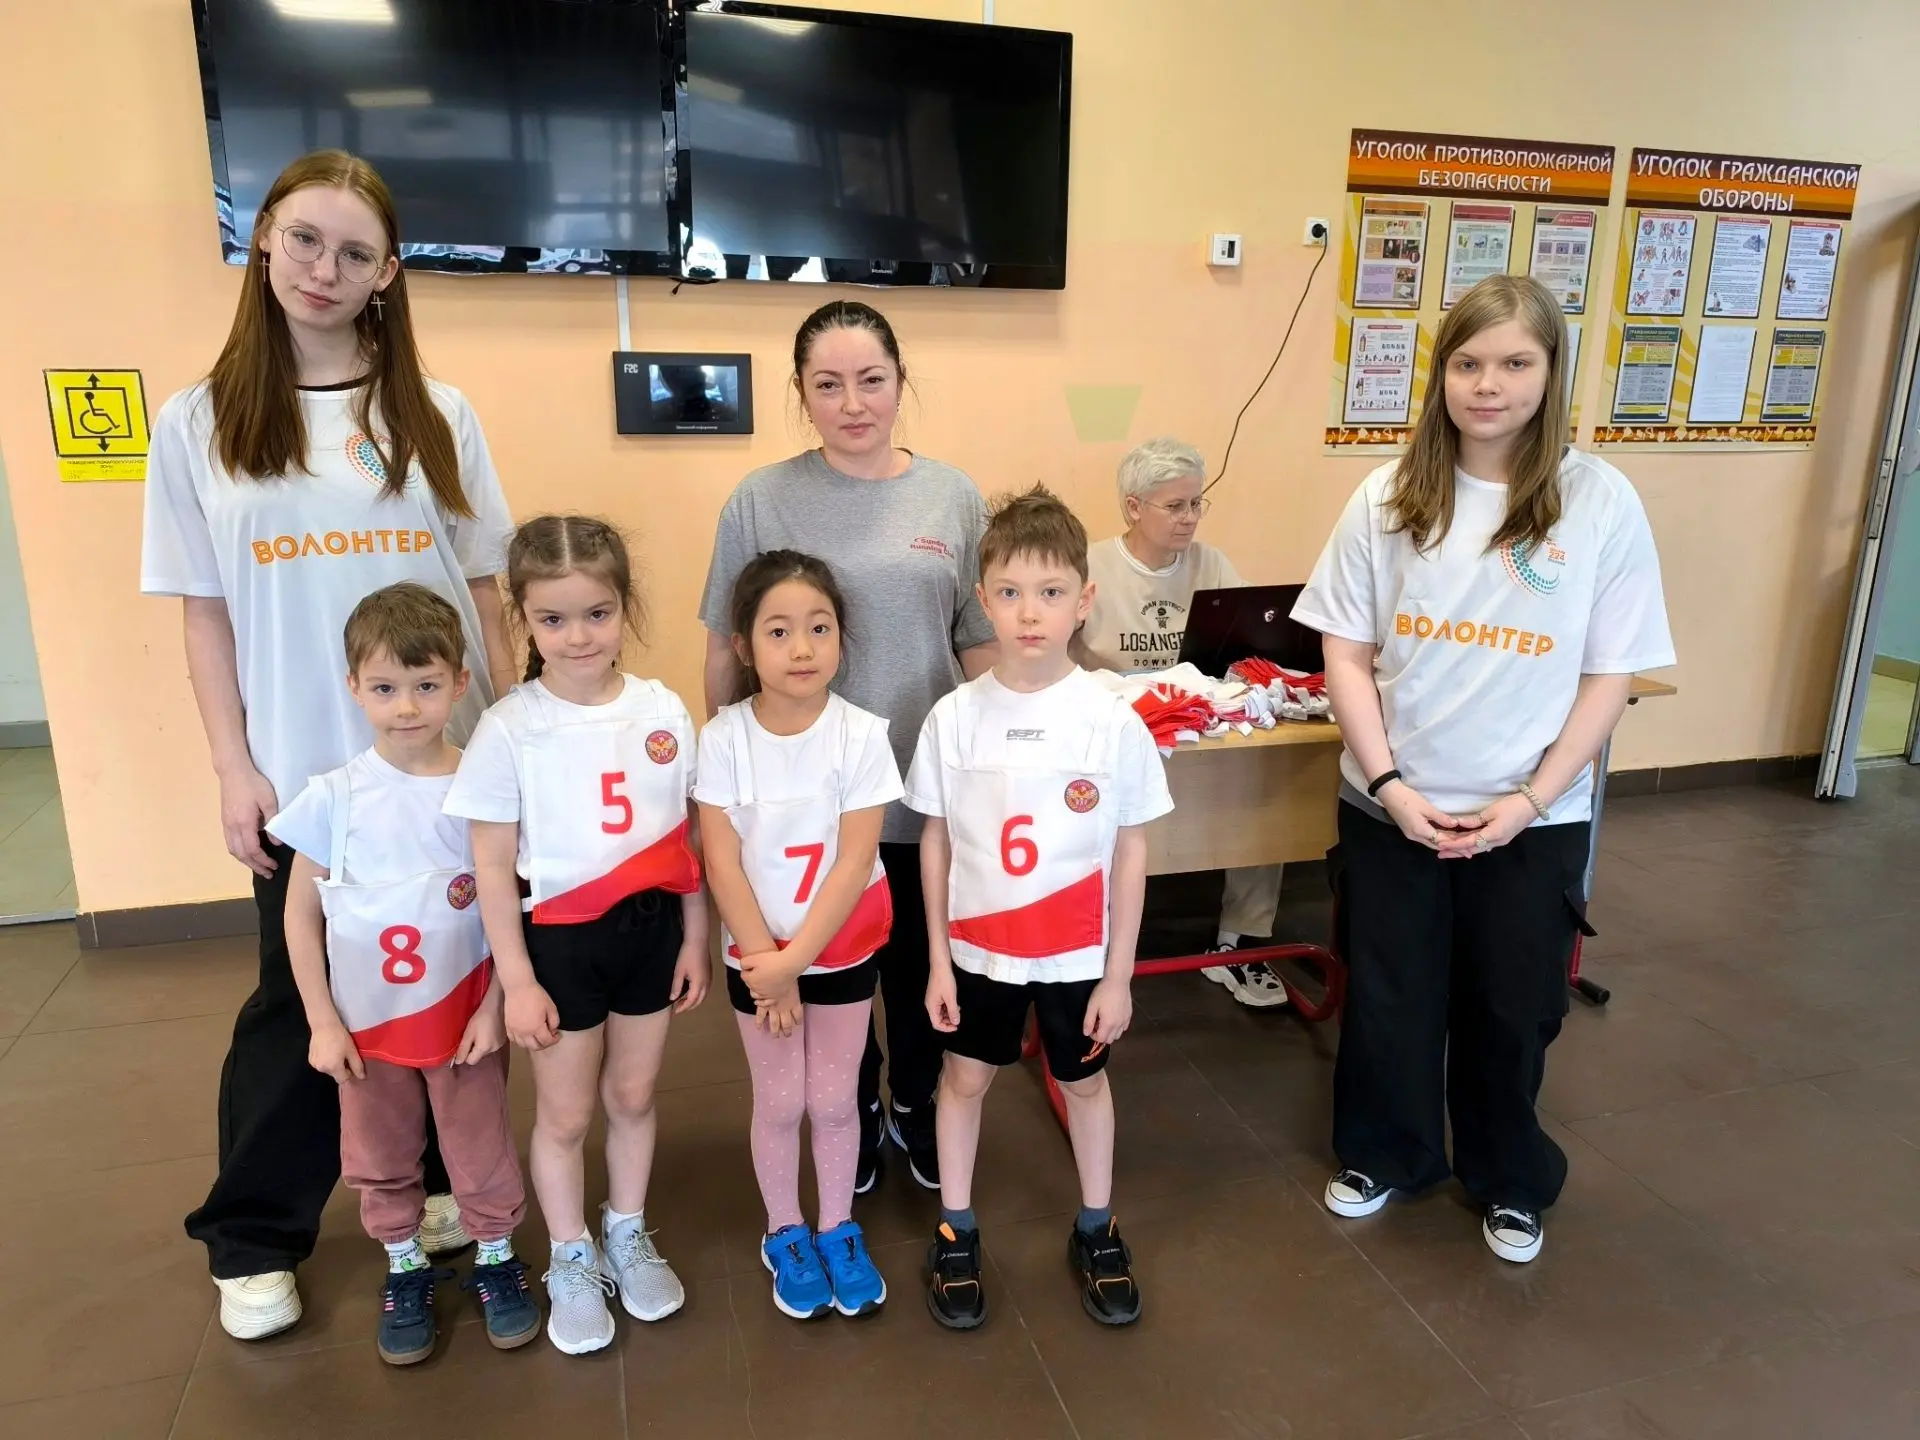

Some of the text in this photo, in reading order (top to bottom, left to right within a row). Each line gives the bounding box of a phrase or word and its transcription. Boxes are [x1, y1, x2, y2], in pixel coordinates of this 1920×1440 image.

[1356, 140, 1612, 173] УГОЛОК ПРОТИВОПОЖАРНОЙ
[1636, 154, 1859, 189] УГОЛОК ГРАЖДАНСКОЙ
[1418, 169, 1552, 193] БЕЗОПАСНОСТИ
[1699, 188, 1794, 212] ОБОРОНЫ
[252, 529, 433, 565] ВОЛОНТЕР
[1396, 613, 1554, 657] ВОЛОНТЕР
[601, 771, 633, 834] 5
[1000, 815, 1038, 876] 6
[784, 842, 825, 903] 7
[379, 925, 426, 984] 8
